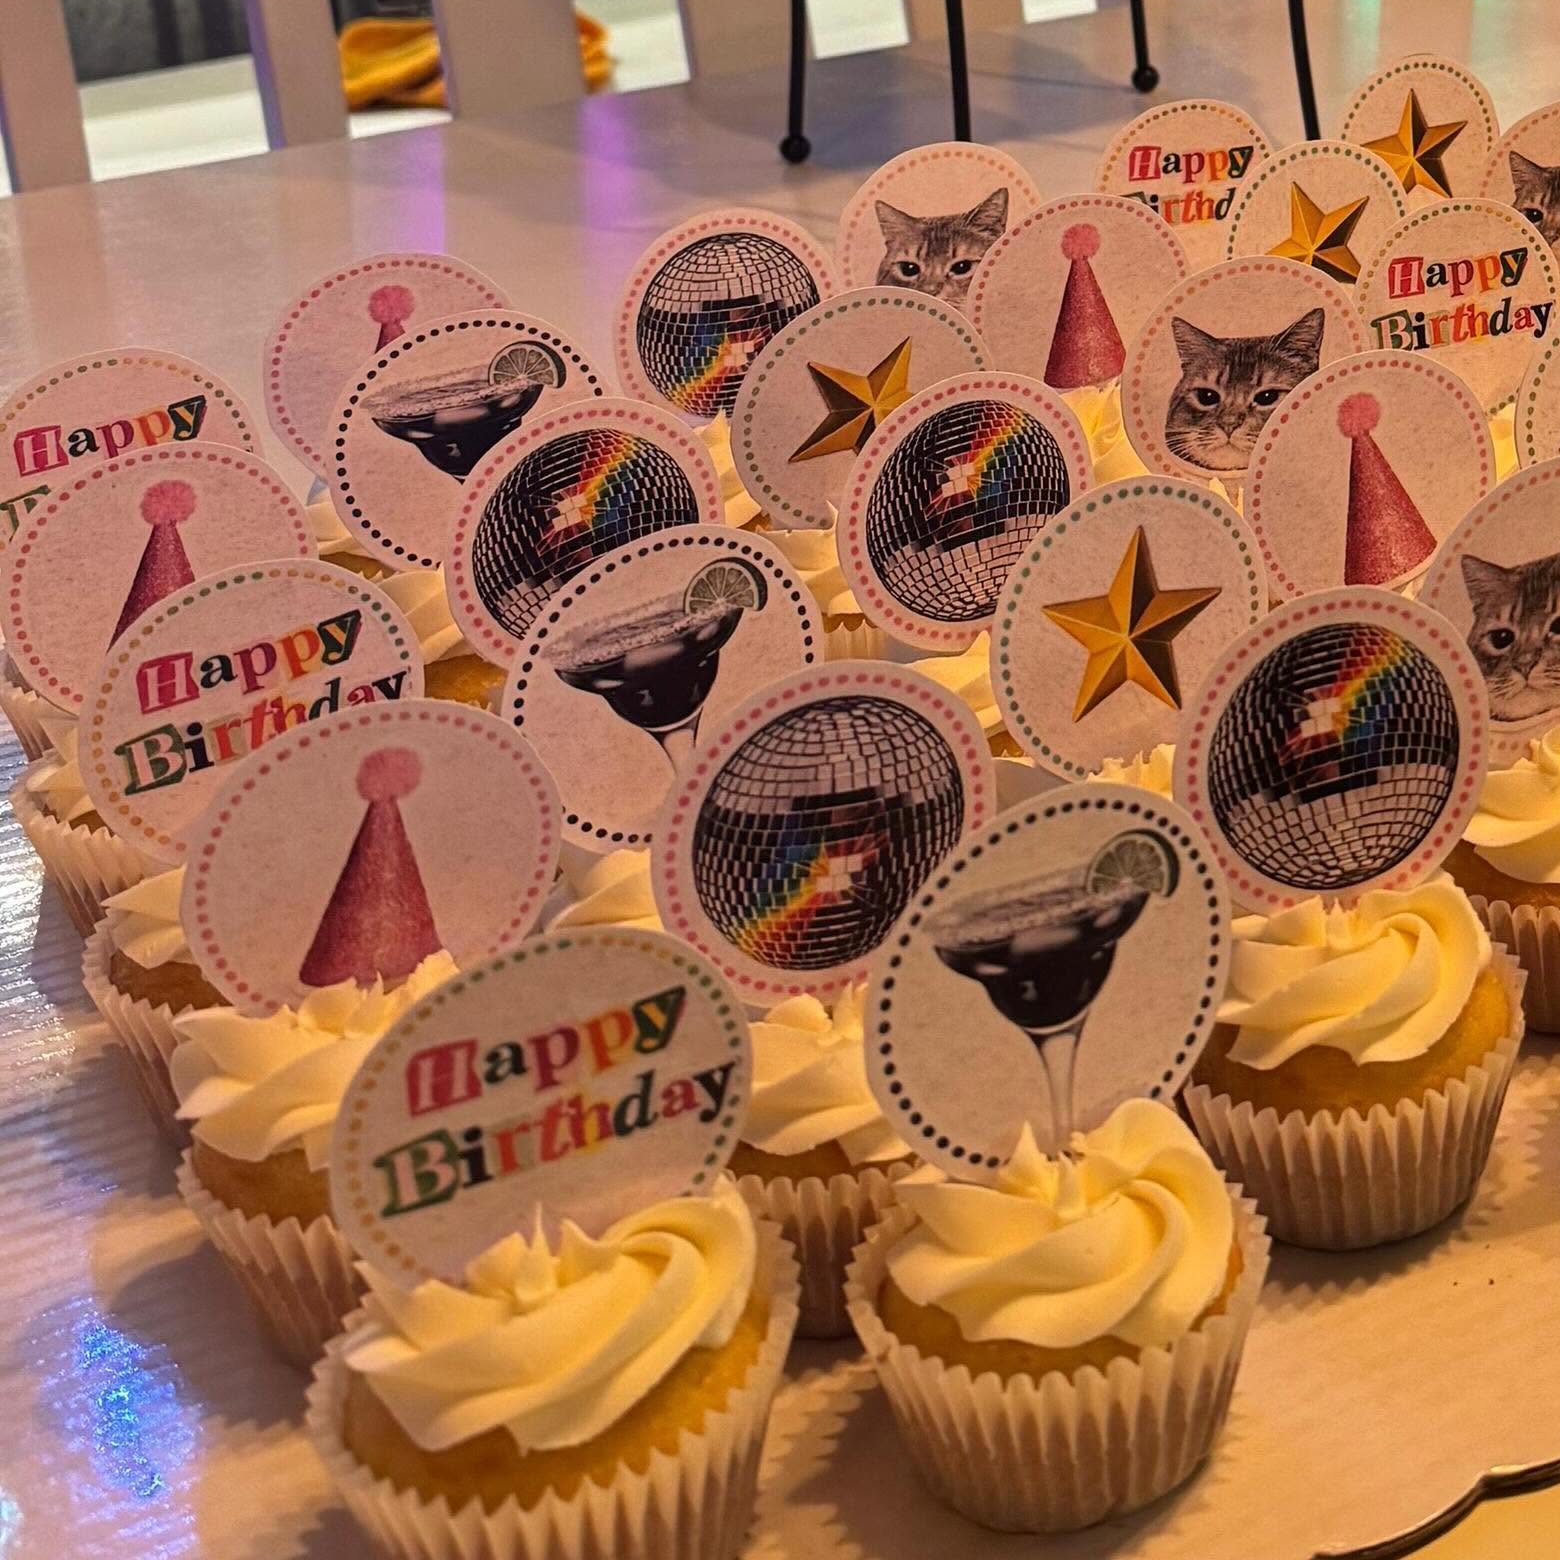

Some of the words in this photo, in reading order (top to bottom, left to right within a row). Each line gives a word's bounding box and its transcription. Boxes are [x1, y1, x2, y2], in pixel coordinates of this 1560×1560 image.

[1128, 145, 1254, 184] Happy
[1119, 186, 1237, 225] irthd
[1388, 246, 1529, 300] Happy
[1371, 296, 1554, 352] Birthday
[13, 394, 208, 478] Happy
[135, 609, 363, 715] Happy
[405, 985, 687, 1119] Happy
[372, 1061, 737, 1219] Birthday
